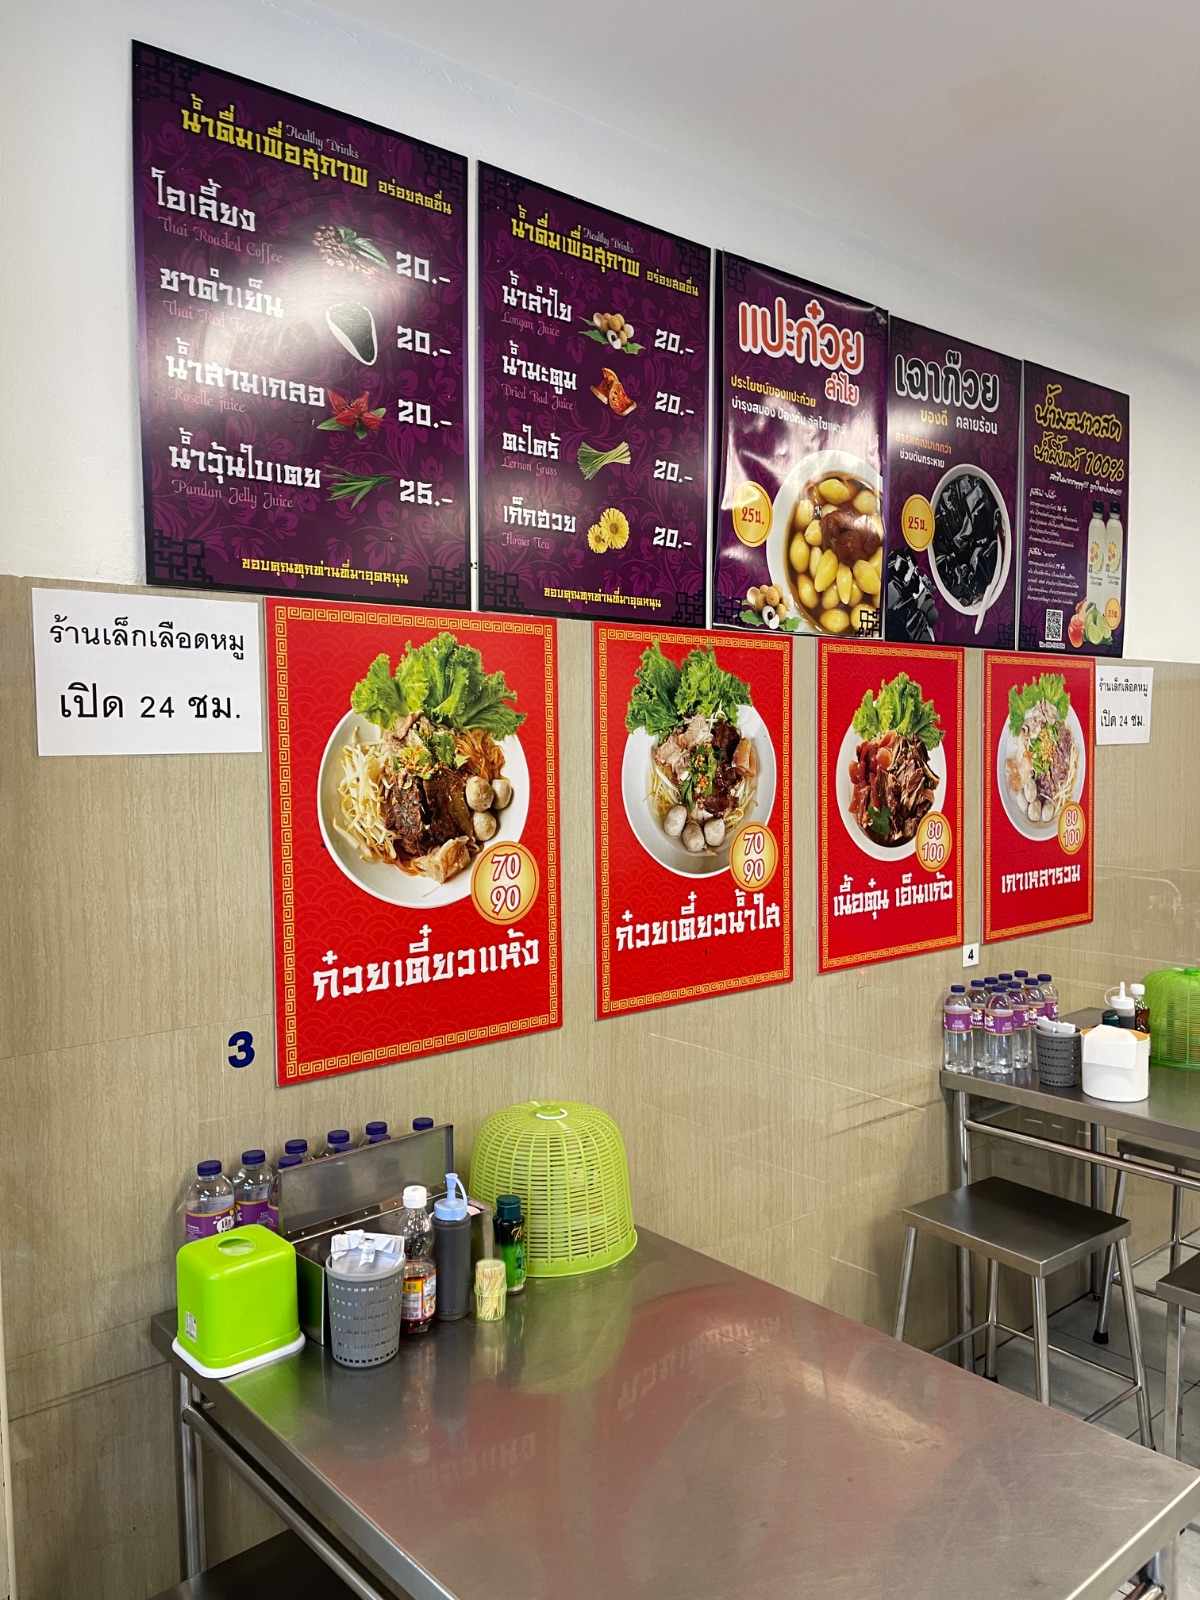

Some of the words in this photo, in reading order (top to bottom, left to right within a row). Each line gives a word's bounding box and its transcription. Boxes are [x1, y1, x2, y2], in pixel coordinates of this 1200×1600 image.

[286, 124, 323, 151] Healthy
[327, 139, 359, 159] Drinks
[151, 167, 256, 232] โอเลี้ยง
[378, 178, 452, 215] อร่อยสดชื่น
[158, 216, 189, 237] Thai
[193, 226, 242, 252] Roasted
[246, 242, 283, 265] Coffee
[583, 227, 610, 249] Healthy
[611, 237, 634, 254] Drinks
[396, 251, 451, 284] 20.-
[160, 267, 284, 319] ชาดำเย็น
[502, 270, 572, 322] น้ำลำไย
[646, 269, 699, 297] อร่อยสดชื่น
[163, 299, 193, 319] Thai
[198, 309, 225, 327] Red
[501, 311, 534, 332] Longan
[537, 320, 560, 337] Juice
[397, 325, 451, 357] 20.-
[654, 328, 694, 355] 20.-
[739, 296, 864, 375] แปะก๋วย
[165, 336, 325, 407] น้ำสามเกลอ
[502, 340, 577, 395] น้ำมะตูม
[895, 349, 999, 413] เฉาก๊วย
[168, 386, 213, 407] Roselle
[219, 395, 245, 413] juice
[501, 384, 526, 400] Dried
[551, 395, 574, 411] Juice
[825, 371, 859, 406] ลำไย
[398, 399, 452, 429] 20.-
[654, 391, 694, 416] 20.-
[731, 396, 776, 415] บำรุงสมอง
[1034, 384, 1122, 442] น้ำมะนาวสด
[920, 408, 948, 426] ของดี
[956, 416, 998, 435] คลายร้อน
[536, 463, 557, 477] Grass
[653, 459, 693, 483] 20.-
[1033, 431, 1086, 471] น้ำผึ้งแท้
[1085, 452, 1124, 482] 100%
[172, 479, 222, 499] Pandan
[229, 487, 257, 509] Jelly
[263, 492, 294, 509] Juice
[399, 479, 453, 508] 25.-
[503, 496, 576, 533] เก็กฮวย
[501, 531, 531, 547] Flower
[534, 537, 550, 550] Tea
[652, 526, 692, 549] 20.-
[241, 558, 409, 587] ขอบคุณทุกท่านที่มาอุดหนุน
[544, 587, 661, 610] ขอบคุณทุกท่านที่มาอุดหนุน
[49, 614, 244, 660] ร้านเล็กเลือดหมู
[60, 681, 124, 718] เปิด
[140, 696, 175, 718] 24
[188, 694, 241, 718] ชม.
[1099, 677, 1149, 697] ร้านเล็กเลือดหมู
[1101, 709, 1117, 727] เปิด
[1119, 715, 1128, 727] 24
[1131, 714, 1146, 727] ชม.
[927, 820, 943, 840] 80
[1066, 809, 1078, 827] 80
[743, 832, 764, 855] 70
[1063, 828, 1081, 847] 100
[922, 842, 944, 863] 100
[491, 853, 521, 882] 70
[743, 859, 764, 884] 90
[1001, 864, 1081, 894] เกาเหลารวม
[490, 885, 521, 915] 90
[833, 874, 889, 920] เนื้อตุ๋น
[895, 871, 953, 908] เอ็นแก้ว
[616, 889, 780, 951] ก๋วยเตี๋ยวน้ำใส
[313, 924, 540, 1001] ก๋วยเตี๋ยวแห้ง
[967, 948, 975, 960] 4
[227, 1031, 255, 1068] 3
